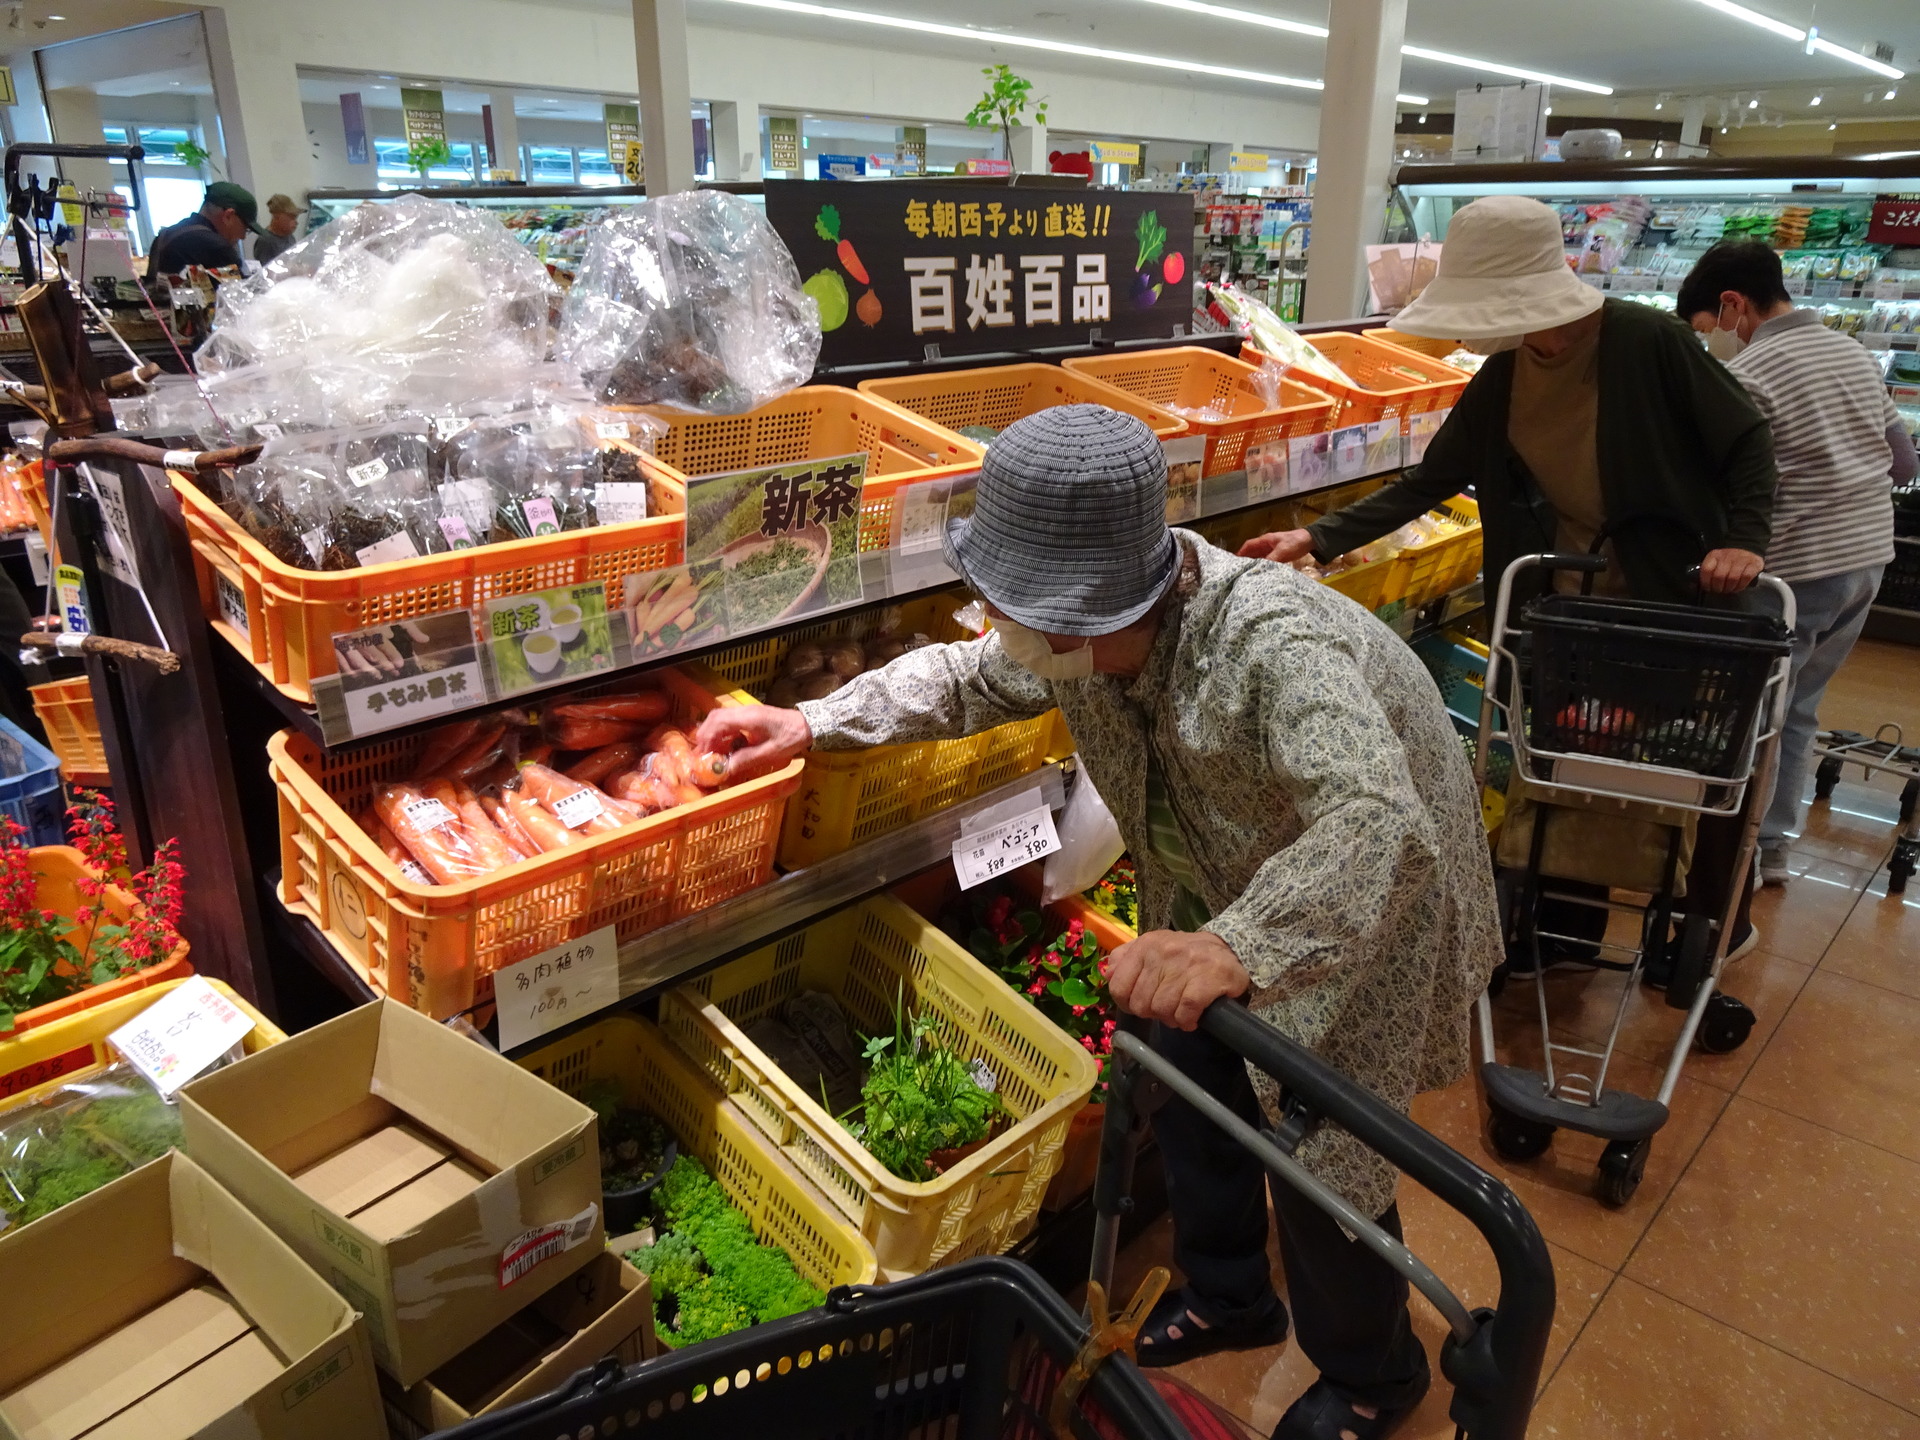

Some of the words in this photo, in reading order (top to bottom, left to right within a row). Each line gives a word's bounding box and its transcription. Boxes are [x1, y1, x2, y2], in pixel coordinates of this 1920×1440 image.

[904, 198, 1111, 239] 毎朝西予より直送!!
[903, 253, 1112, 336] 百姓百品
[355, 463, 383, 482] 新茶
[760, 462, 862, 538] 新茶
[492, 603, 541, 637] 新茶
[366, 670, 468, 714] 手もみ番茶
[1001, 823, 1040, 850] ベゴニア
[1024, 838, 1048, 858] ¥80
[515, 944, 595, 991] 多肉植物
